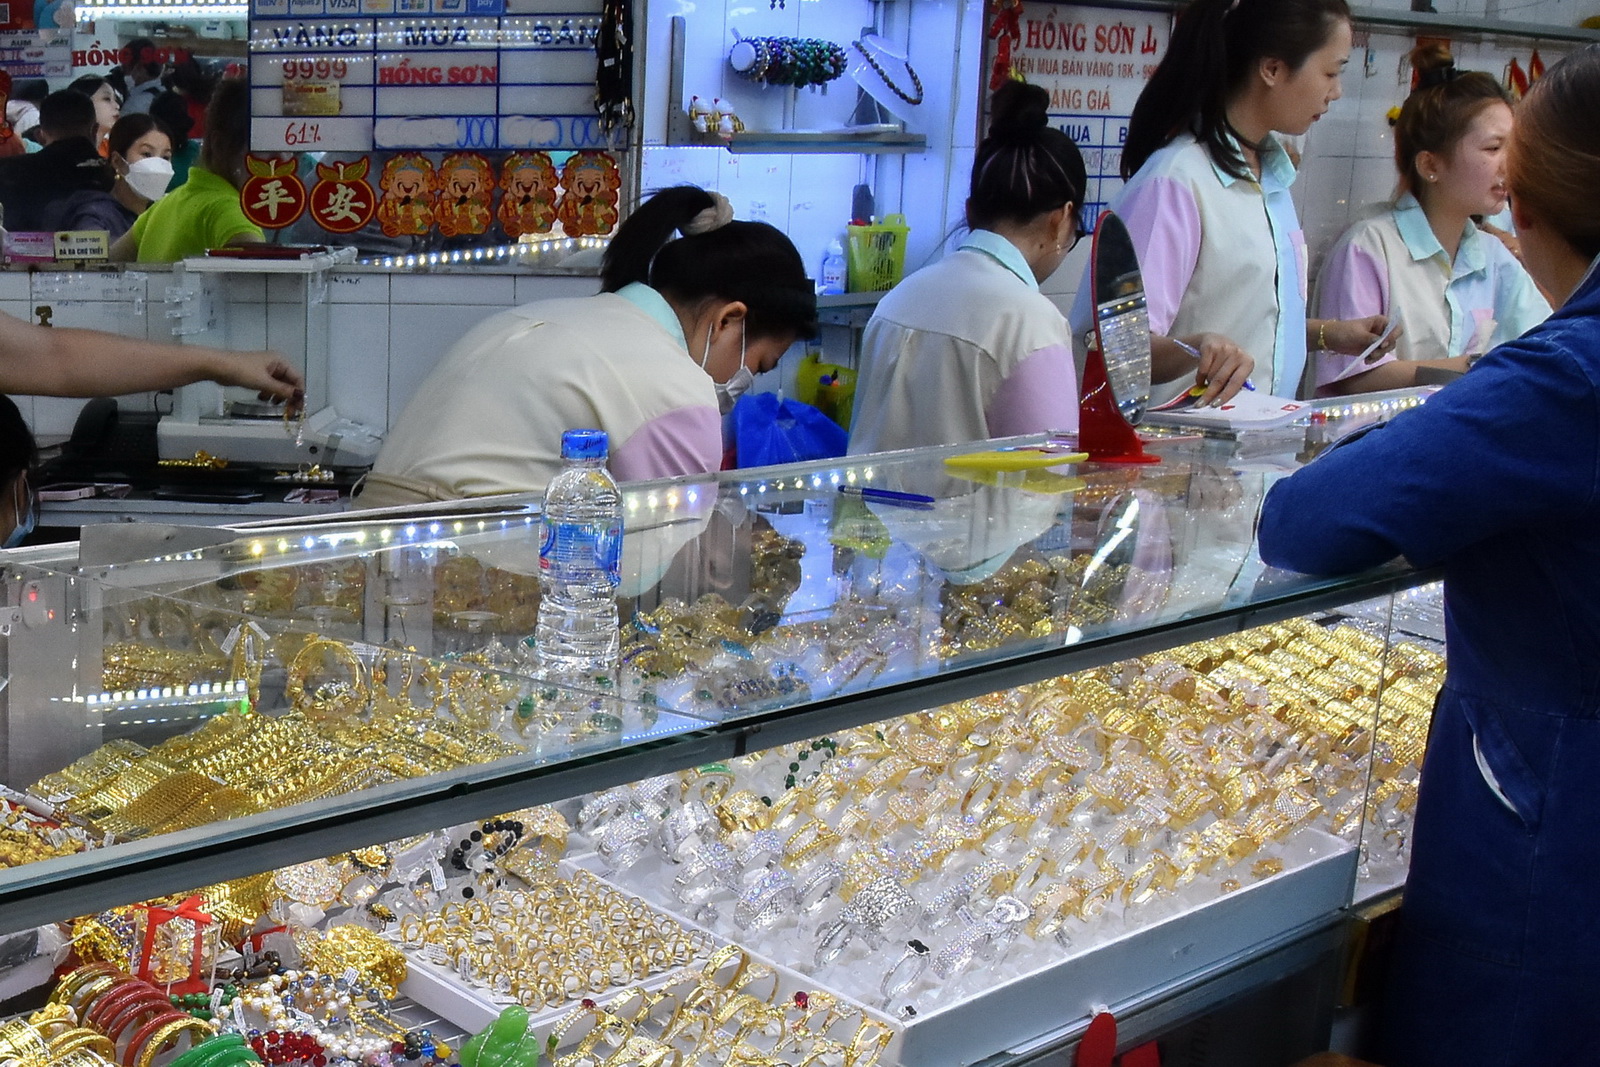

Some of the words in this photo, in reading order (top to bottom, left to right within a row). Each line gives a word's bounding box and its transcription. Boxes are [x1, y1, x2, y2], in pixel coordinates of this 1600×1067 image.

[329, 0, 357, 8] VISA
[273, 22, 358, 47] VÀNG
[404, 26, 469, 46] MUA
[1025, 8, 1087, 53] HỒNG
[1094, 21, 1136, 55] SƠN
[282, 60, 348, 80] 9999
[448, 64, 498, 84] SƠN
[1037, 59, 1059, 75] MUA
[1046, 80, 1082, 110] ẢNG
[1087, 84, 1110, 111] GIÁ
[285, 122, 322, 146] 61%
[251, 179, 296, 221] 平
[320, 183, 367, 224] 安
